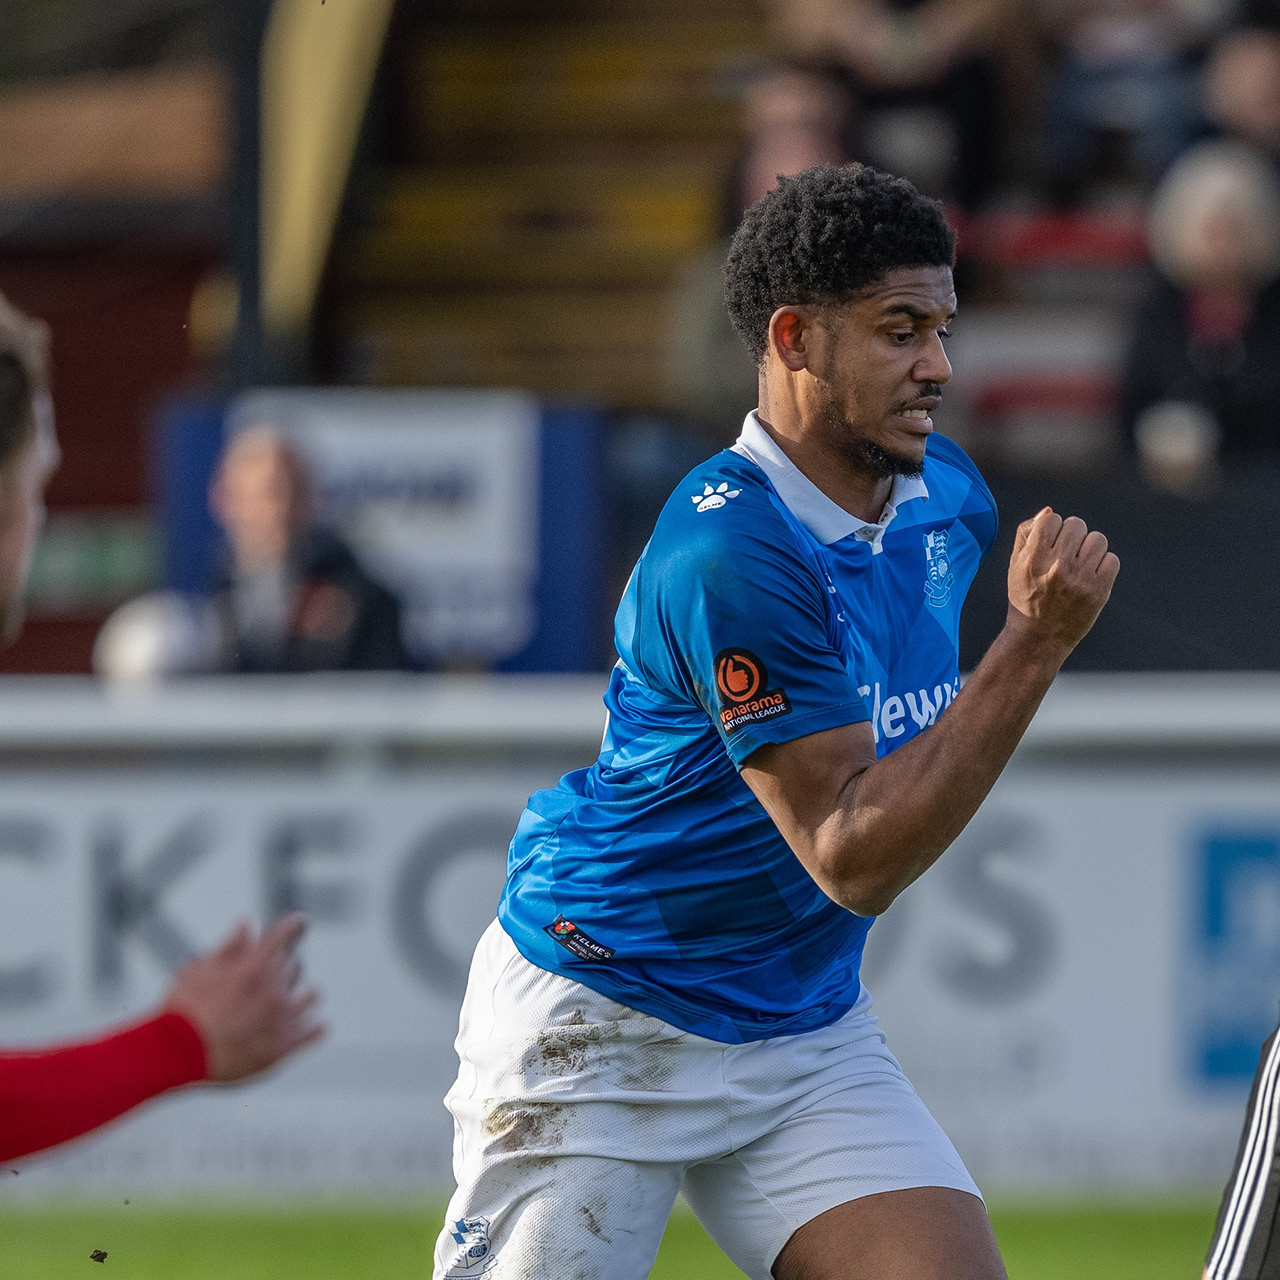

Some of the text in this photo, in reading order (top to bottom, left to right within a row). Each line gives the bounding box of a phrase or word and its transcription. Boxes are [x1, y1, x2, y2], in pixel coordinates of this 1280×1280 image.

[698, 501, 723, 511] KELME
[719, 693, 784, 723] vanarama
[723, 703, 787, 731] NATIONAL LEAGUE
[569, 940, 588, 955] OFFICIAL
[573, 933, 606, 956] KELME
